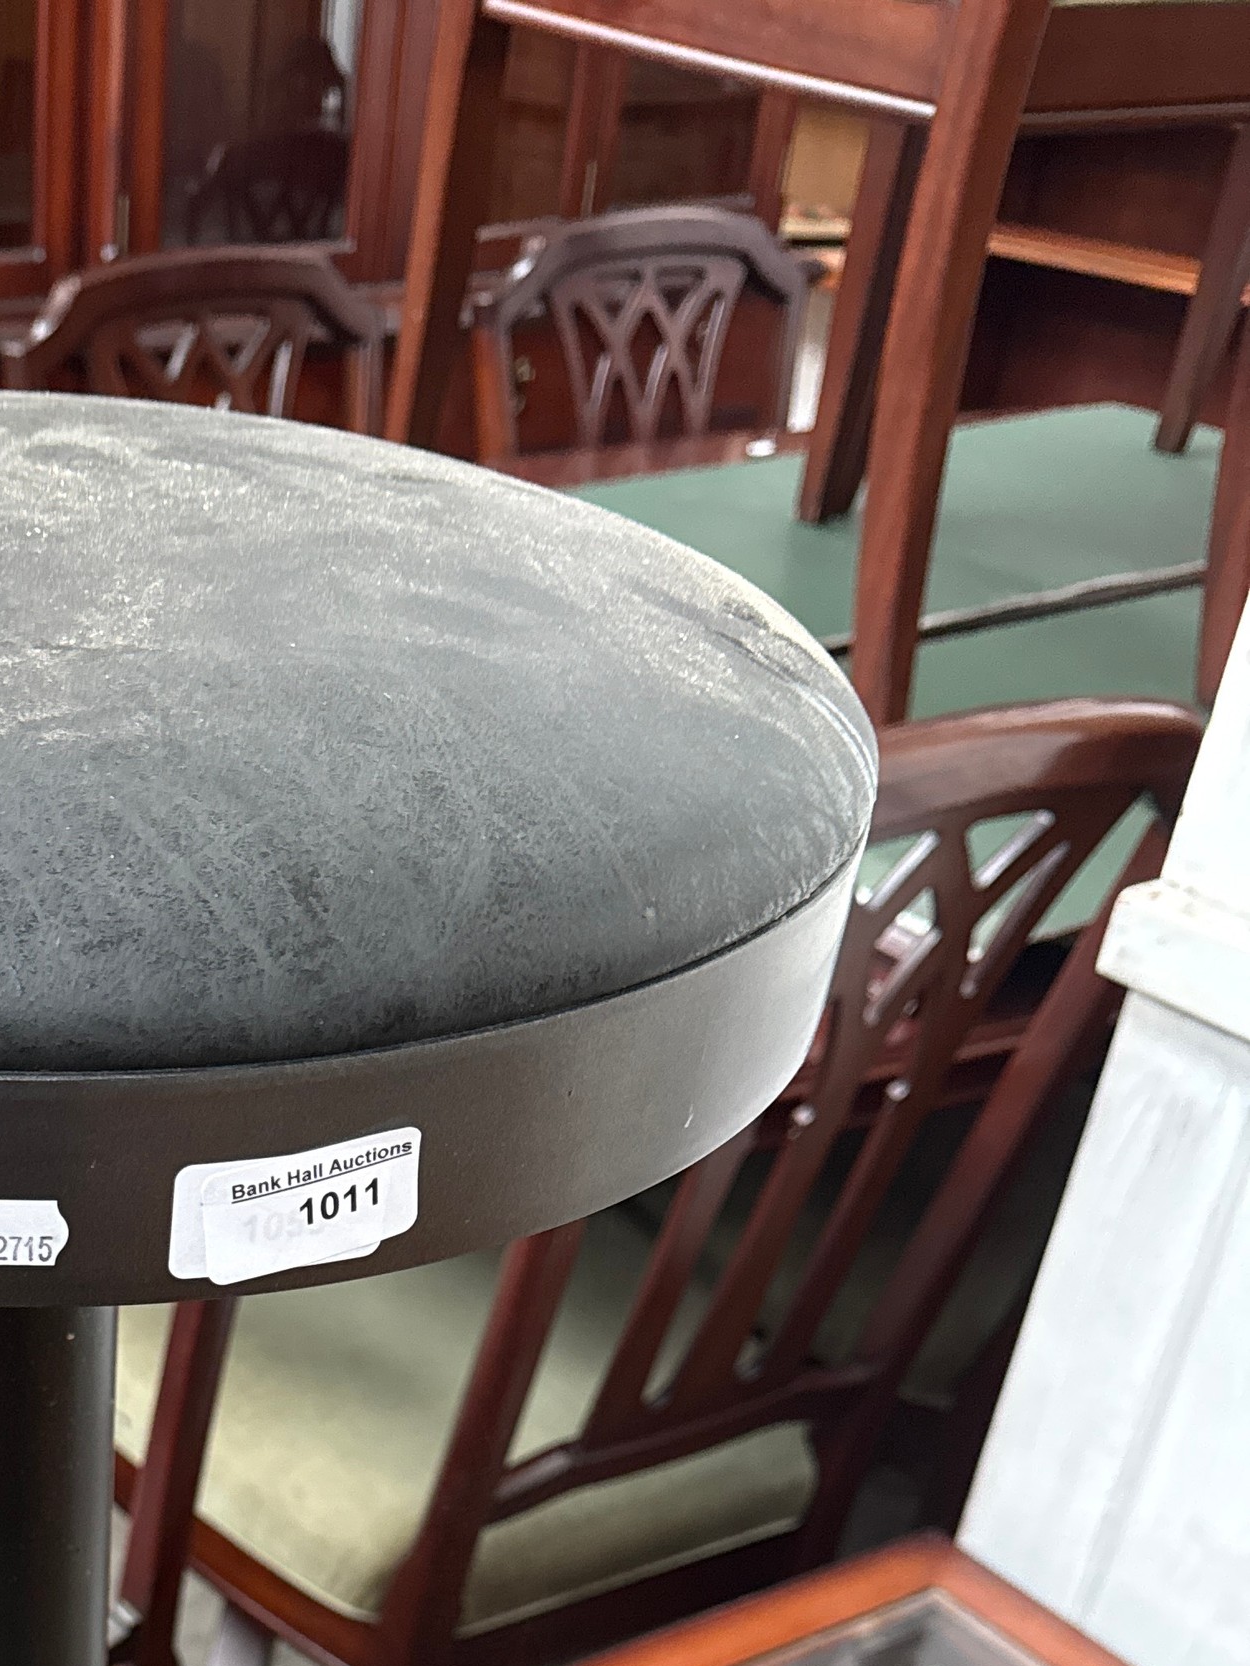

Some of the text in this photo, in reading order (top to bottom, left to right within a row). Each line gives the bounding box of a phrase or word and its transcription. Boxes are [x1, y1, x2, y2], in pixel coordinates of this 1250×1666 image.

[232, 1141, 412, 1200] Bank Hall Auctions
[299, 1177, 379, 1226] 1011
